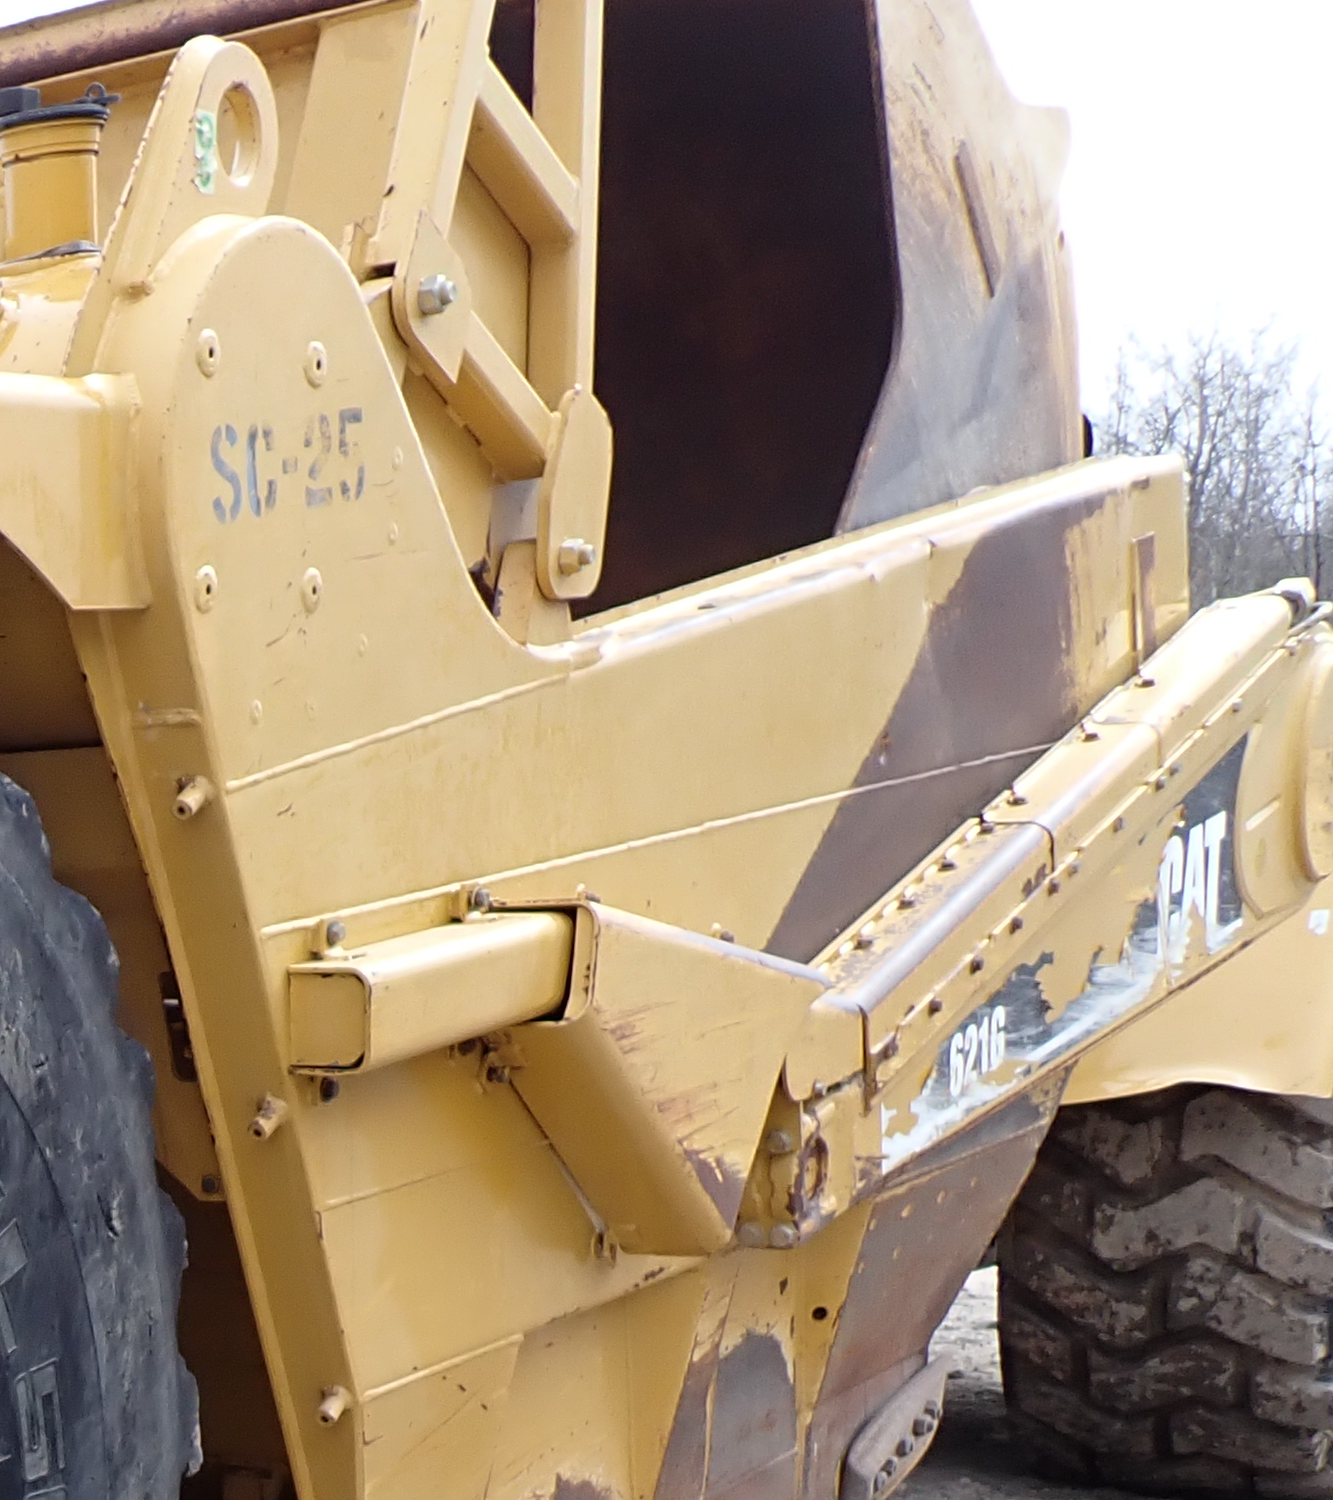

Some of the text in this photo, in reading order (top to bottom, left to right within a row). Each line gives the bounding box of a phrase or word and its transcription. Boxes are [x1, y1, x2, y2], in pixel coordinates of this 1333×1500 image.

[211, 407, 364, 525] SC-25
[1156, 810, 1227, 958] CAT
[949, 1004, 1006, 1098] 621G
